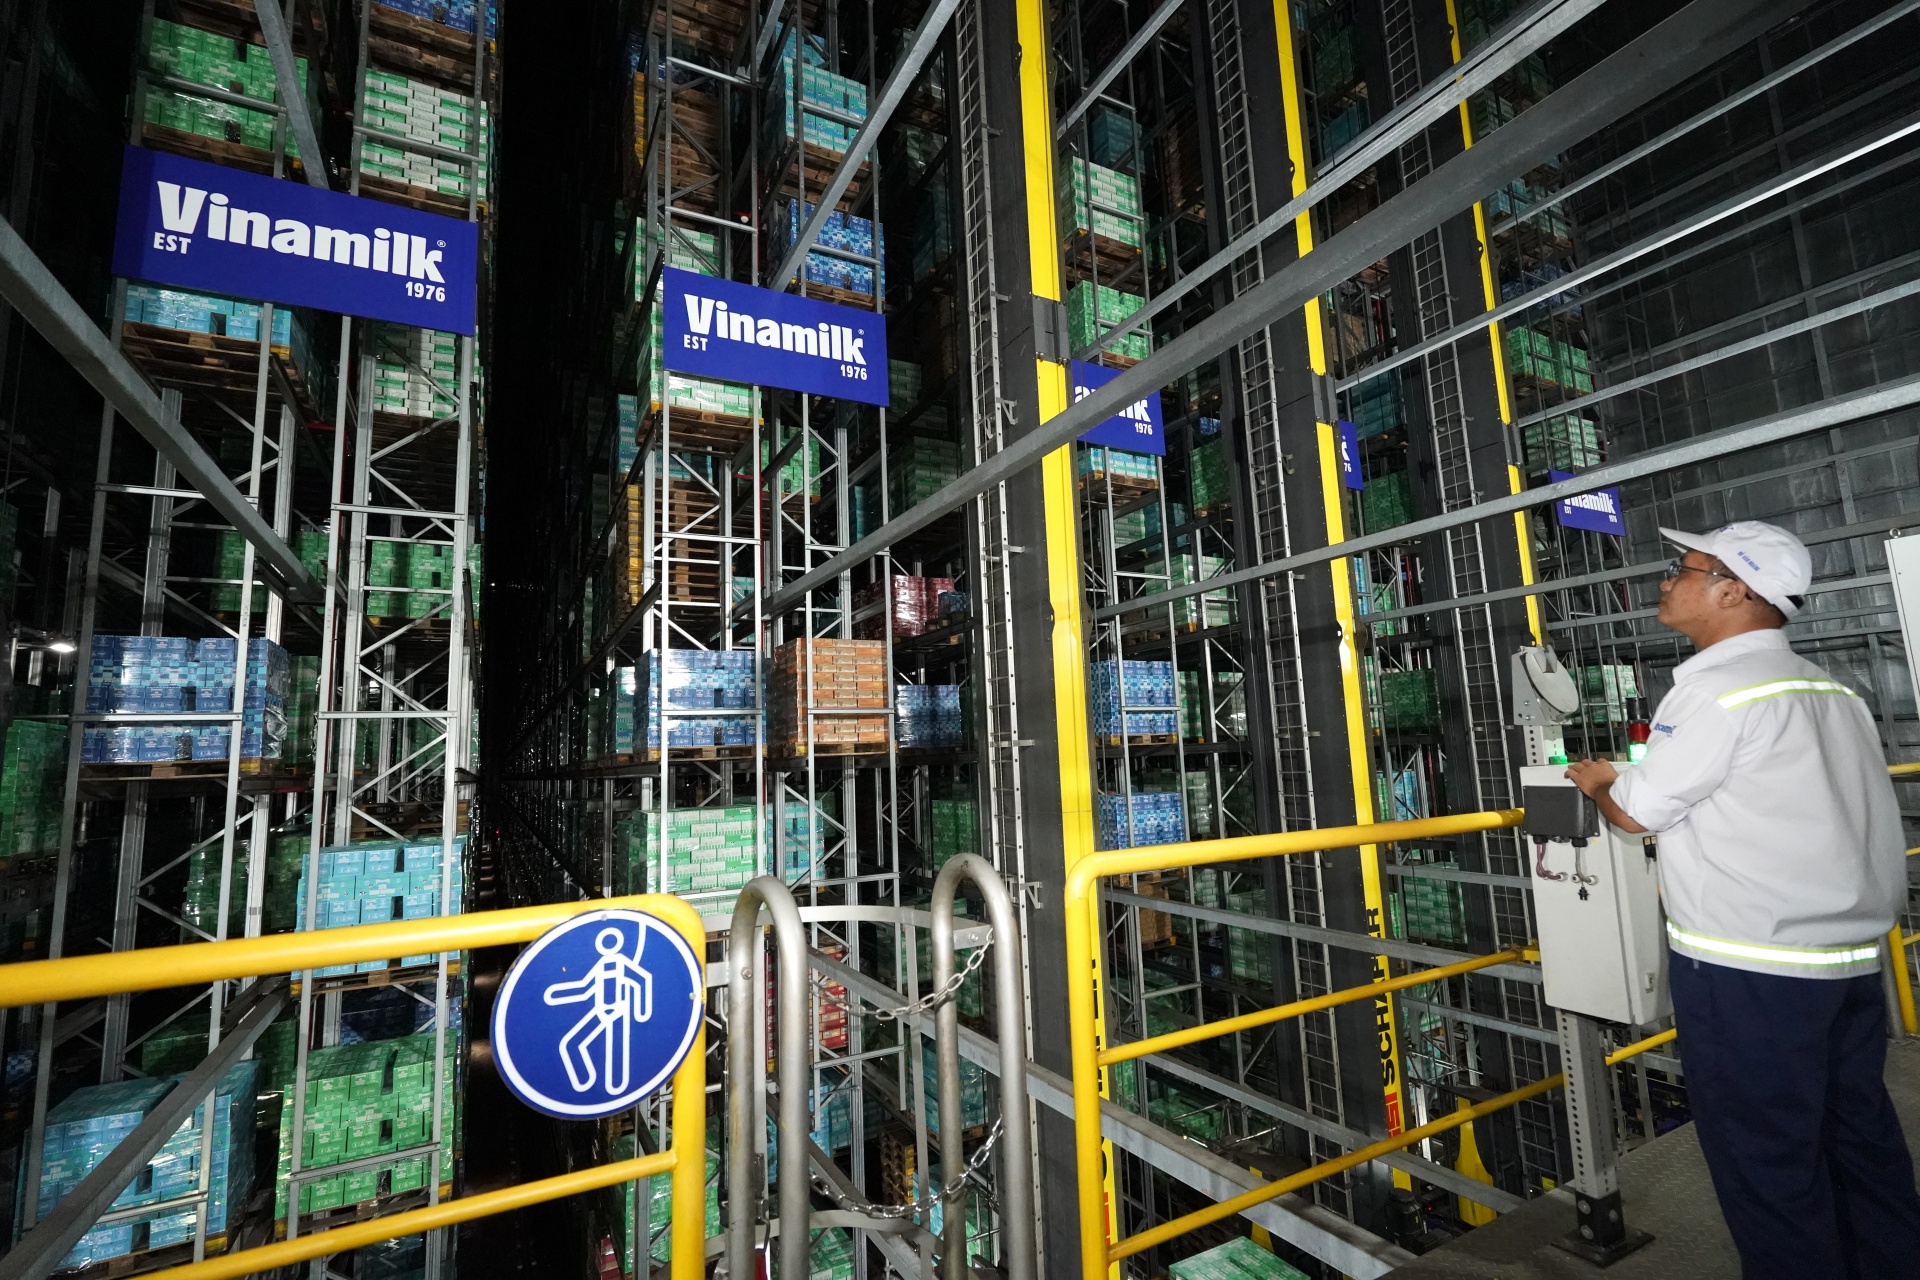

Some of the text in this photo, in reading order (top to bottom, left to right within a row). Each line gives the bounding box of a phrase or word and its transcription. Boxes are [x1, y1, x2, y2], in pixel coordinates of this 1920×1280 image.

[154, 232, 446, 302] EST 1976
[157, 181, 446, 284] Vinamilk
[684, 294, 866, 365] Vinamilk
[684, 334, 867, 380] EST 1976
[1135, 422, 1153, 435] 1976
